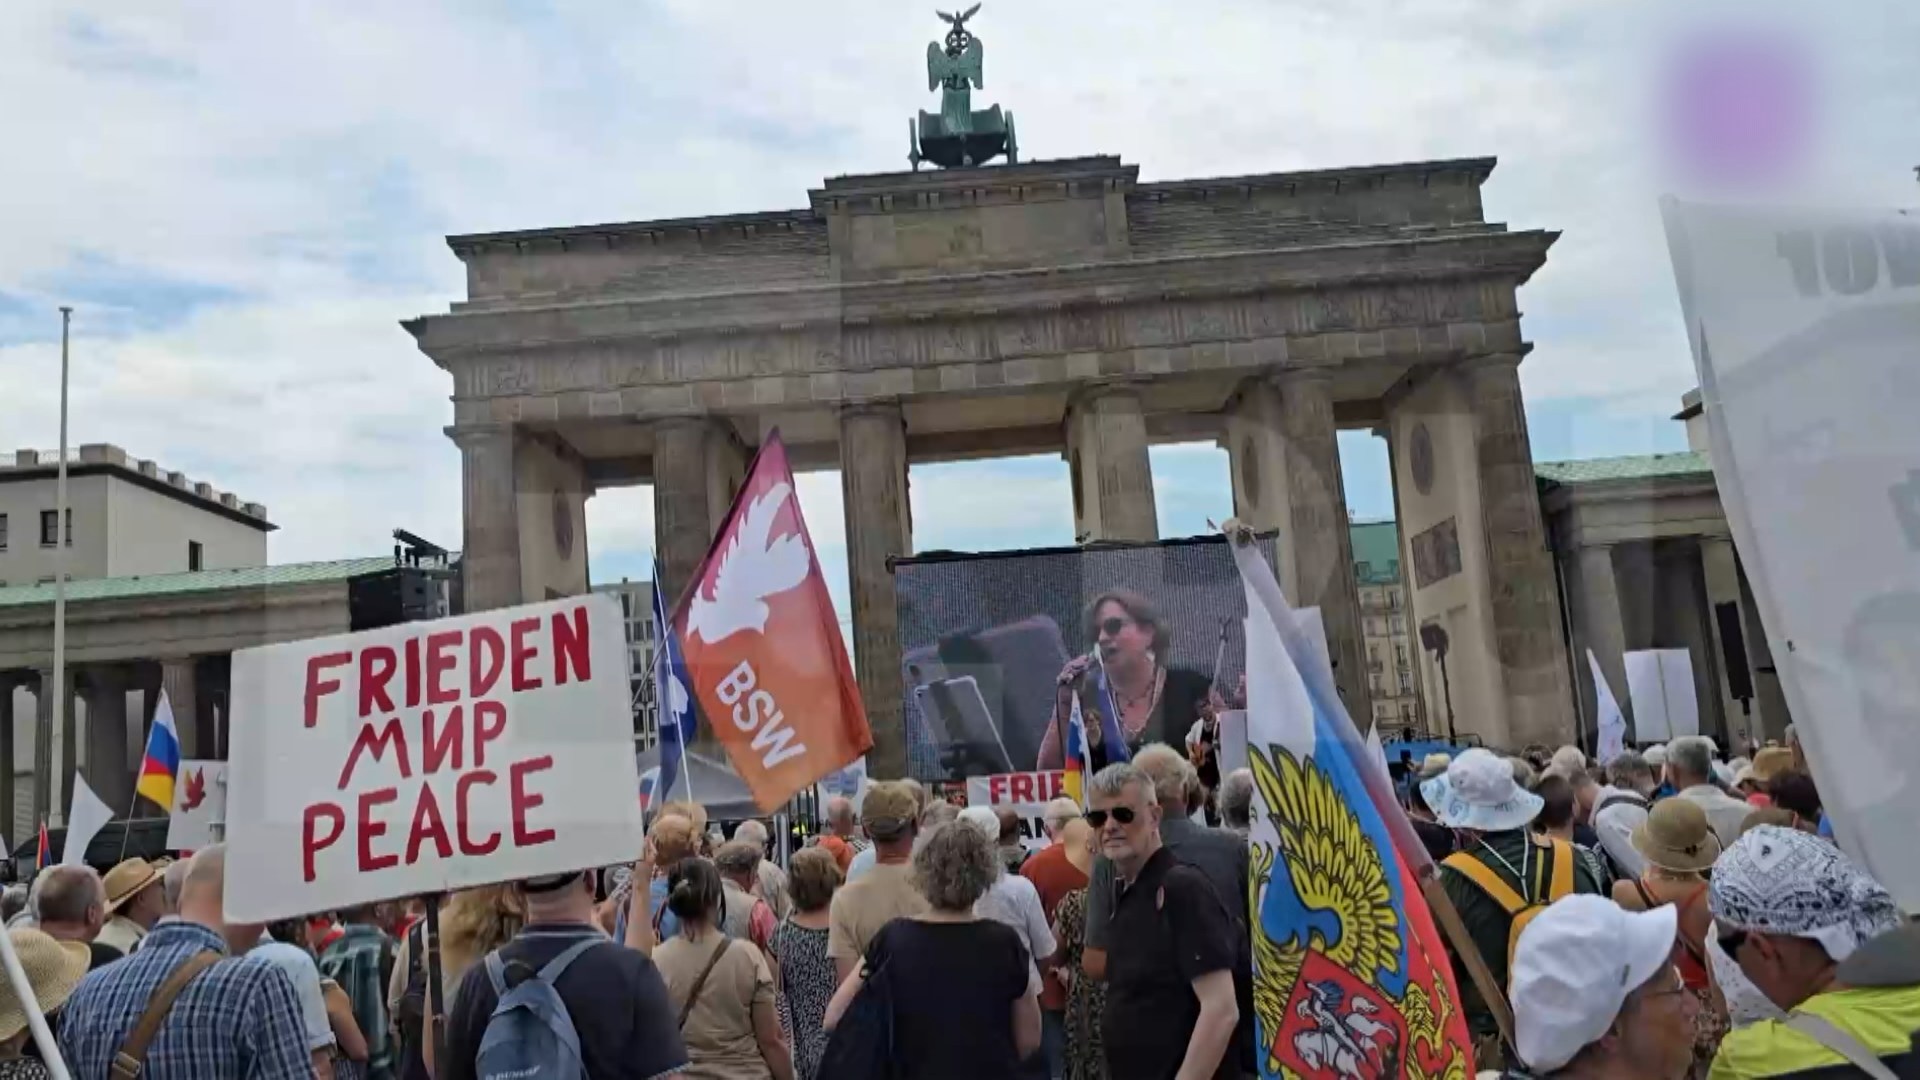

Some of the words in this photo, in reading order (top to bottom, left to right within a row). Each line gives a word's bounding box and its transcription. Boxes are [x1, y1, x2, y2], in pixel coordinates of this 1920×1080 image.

[303, 606, 592, 728] FRIEDEN
[715, 659, 806, 769] BSW
[338, 701, 507, 790] МИР
[303, 755, 556, 883] PEACE
